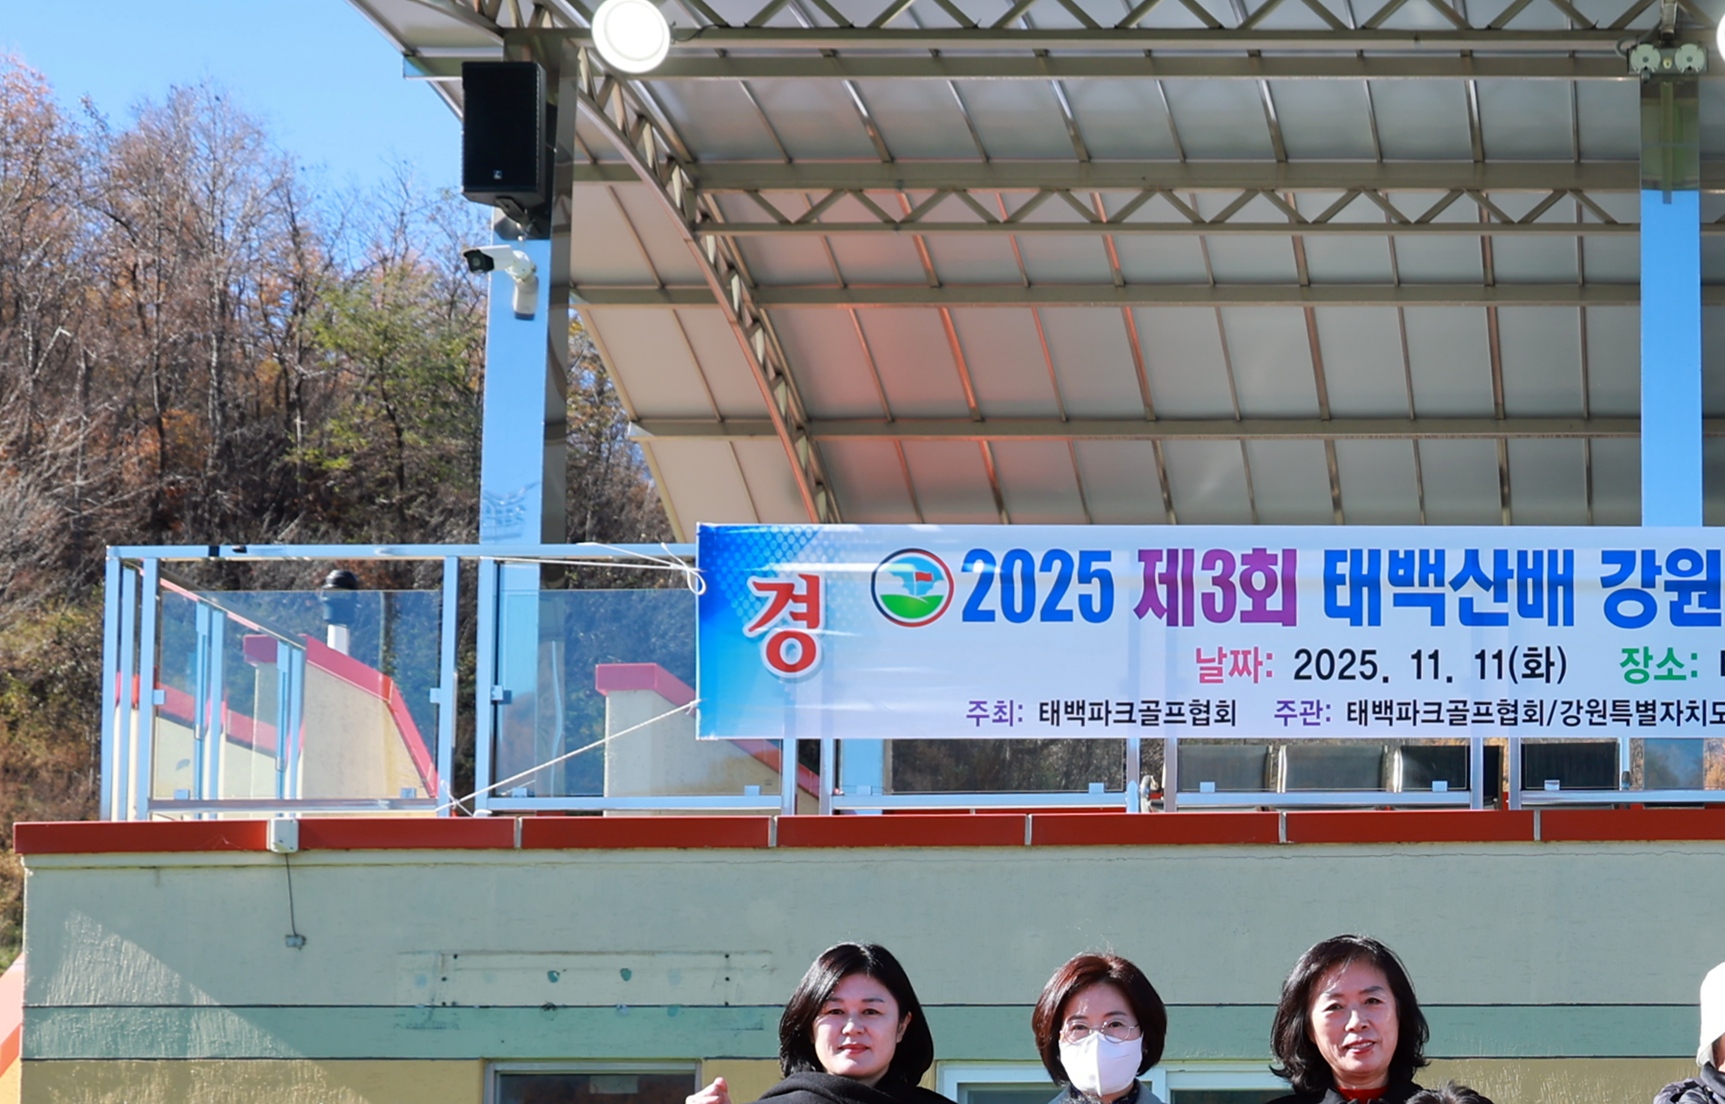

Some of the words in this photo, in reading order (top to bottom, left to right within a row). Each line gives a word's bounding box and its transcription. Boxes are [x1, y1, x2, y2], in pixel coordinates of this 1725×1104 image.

[960, 547, 1116, 625] 2025
[1134, 547, 1298, 627] 제3회
[1322, 547, 1575, 628] 태백산배
[748, 573, 822, 675] 경
[1195, 646, 1274, 685] 날짜:
[1293, 648, 1390, 684] 2025.
[1410, 648, 1454, 684] 11.
[1473, 644, 1568, 685] 11(화)
[1619, 645, 1700, 685] 장소:
[965, 699, 1024, 727] 주최:
[1039, 699, 1237, 728] 태백파크골프협회
[1273, 699, 1331, 728] 주관:
